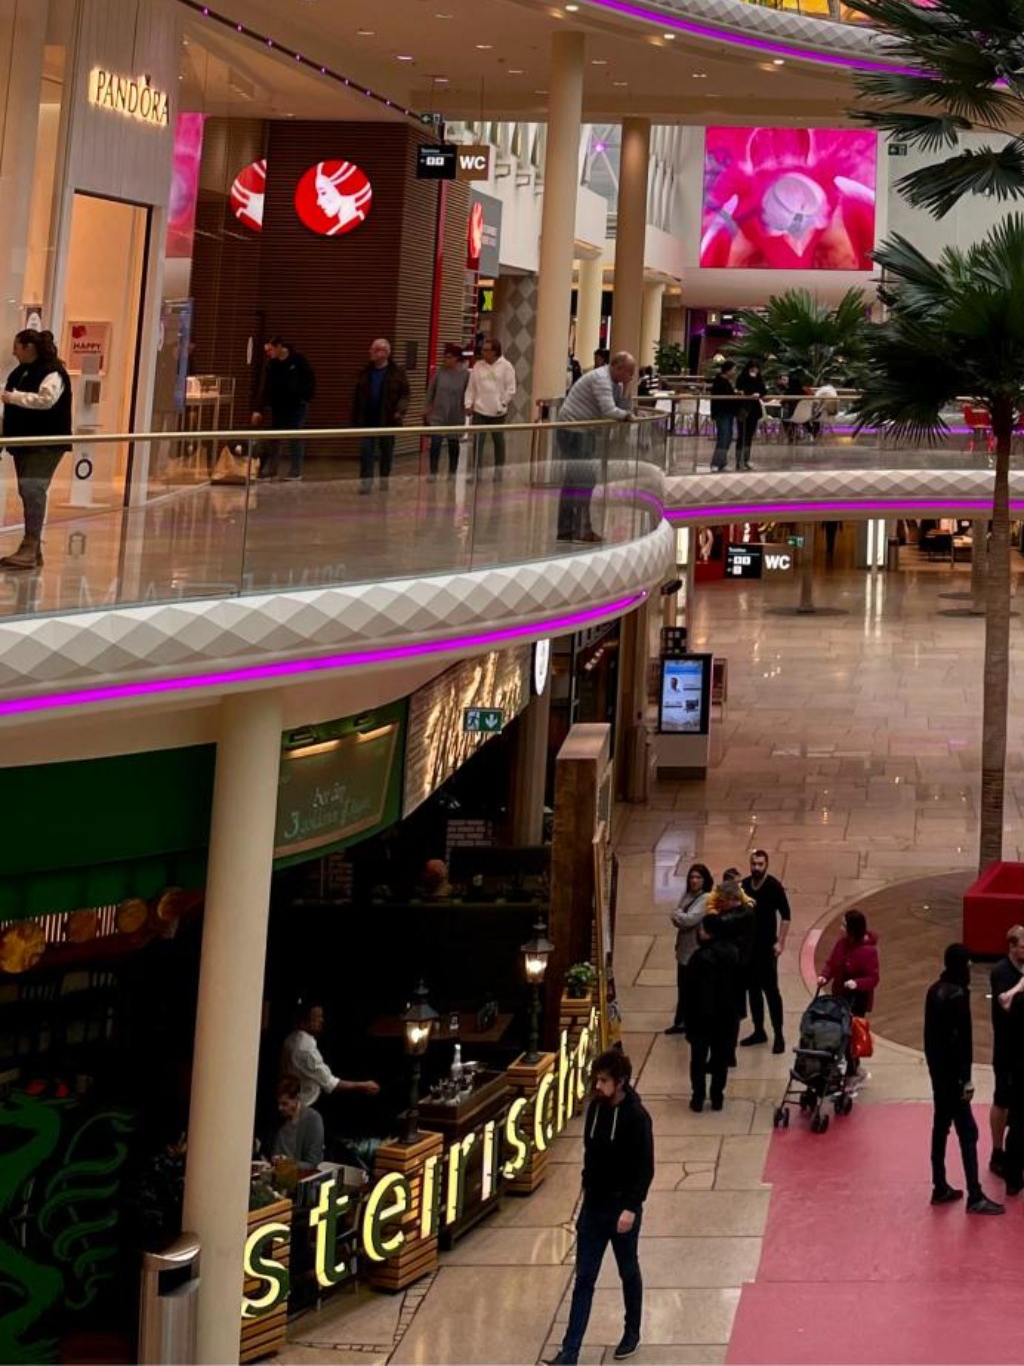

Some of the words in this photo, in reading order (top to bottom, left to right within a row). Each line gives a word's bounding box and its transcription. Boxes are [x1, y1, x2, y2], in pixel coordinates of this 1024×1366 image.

[95, 70, 169, 125] PANDORA
[460, 155, 486, 170] WC
[765, 555, 791, 570] WC
